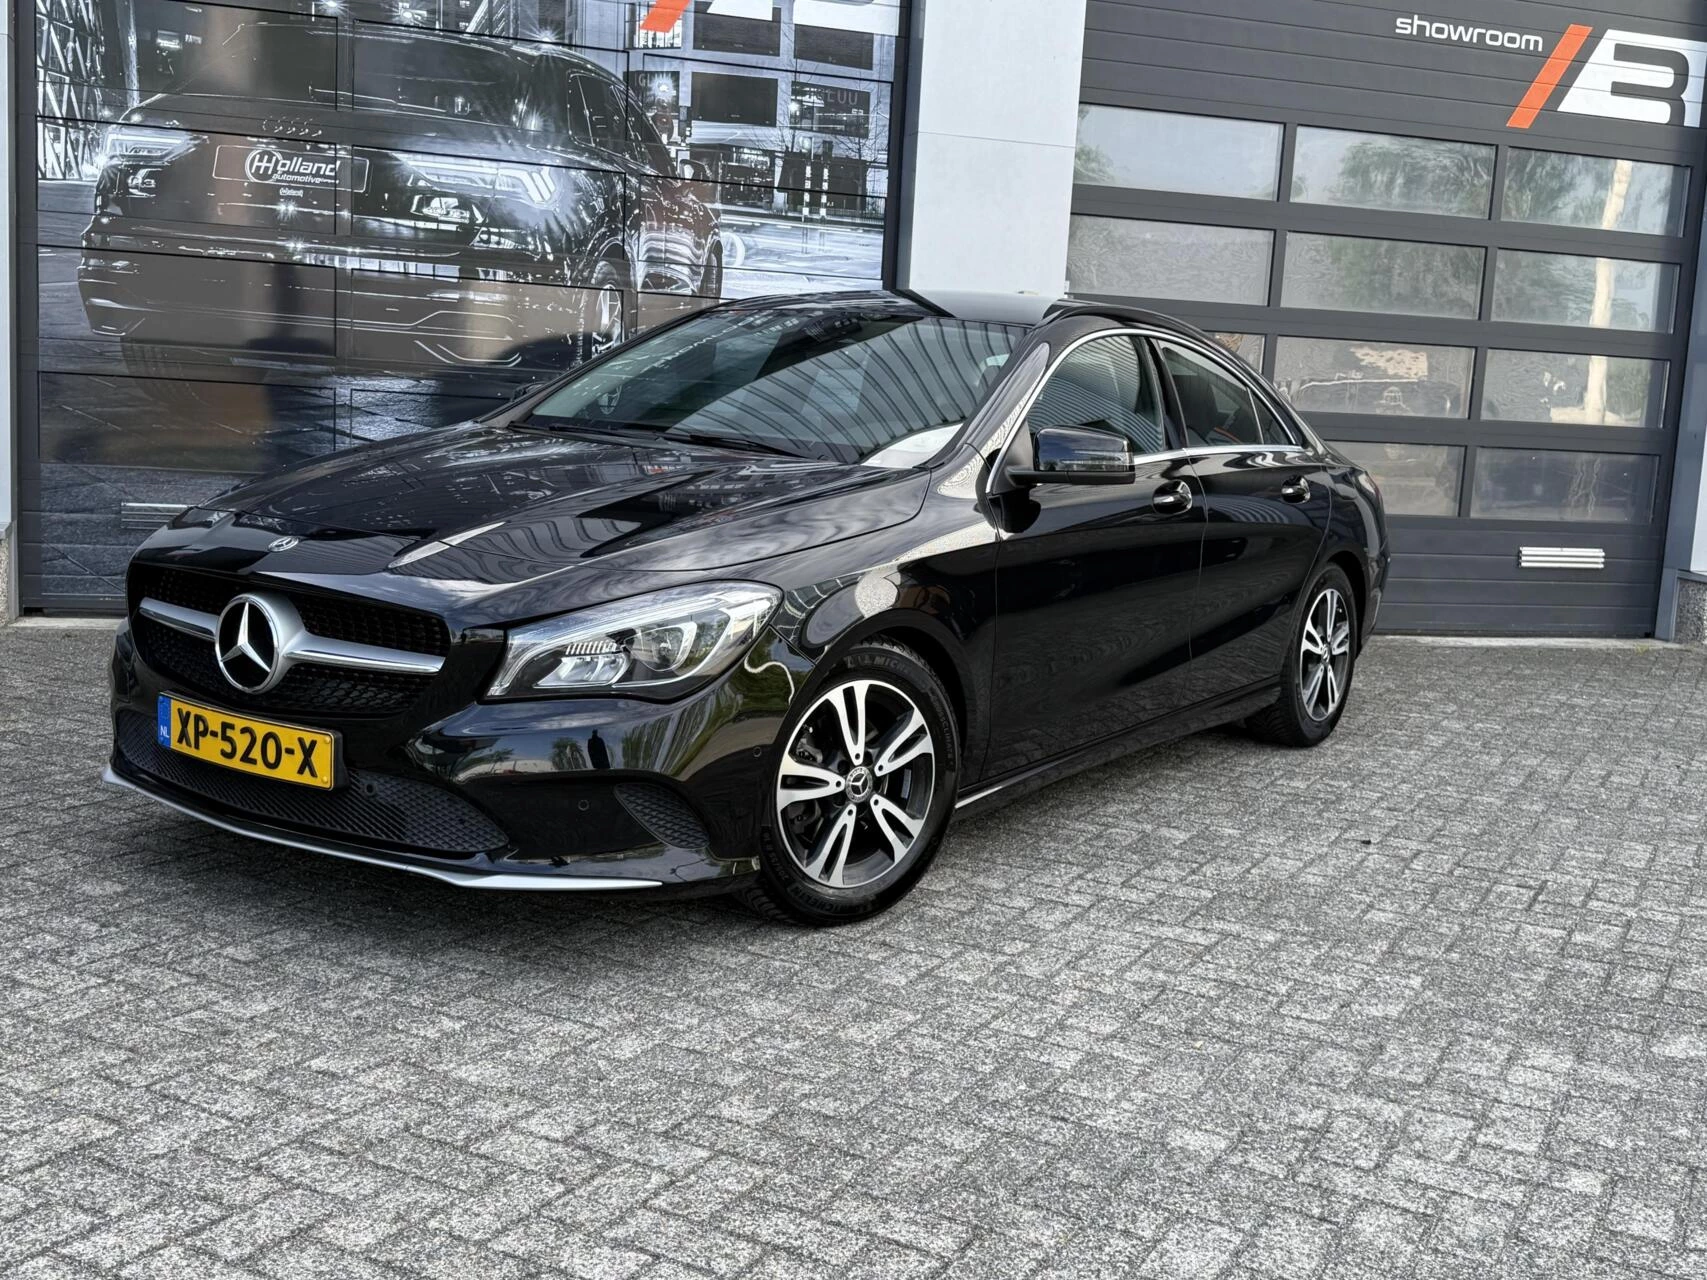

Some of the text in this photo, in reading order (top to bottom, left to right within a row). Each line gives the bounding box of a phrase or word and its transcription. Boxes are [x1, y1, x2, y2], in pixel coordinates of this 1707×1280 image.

[1395, 14, 1543, 52] showroom
[272, 173, 322, 184] automotive
[160, 725, 170, 738] NL
[177, 708, 318, 778] XP-520-X
